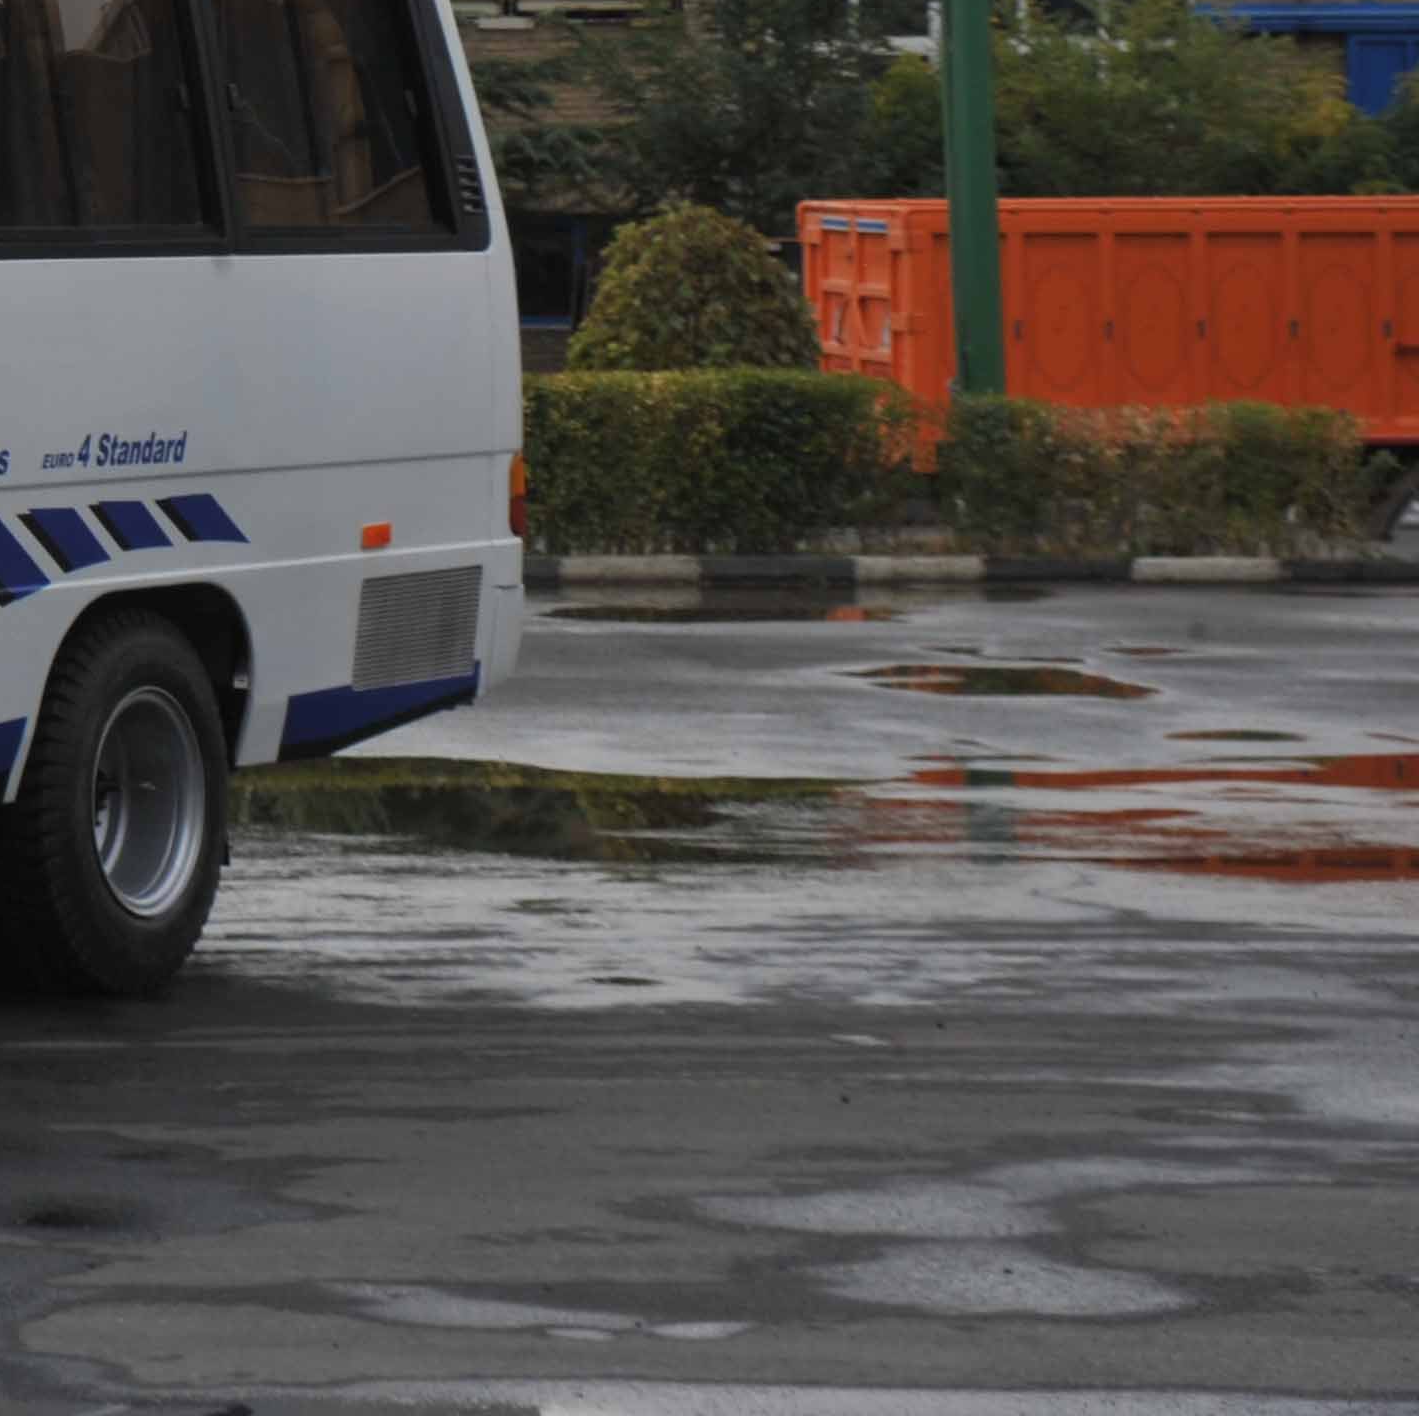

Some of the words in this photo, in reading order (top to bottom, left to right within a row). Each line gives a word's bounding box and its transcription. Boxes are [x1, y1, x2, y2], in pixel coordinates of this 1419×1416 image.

[41, 452, 74, 470] EURO
[77, 434, 92, 468] 4
[96, 430, 188, 468] Standard
